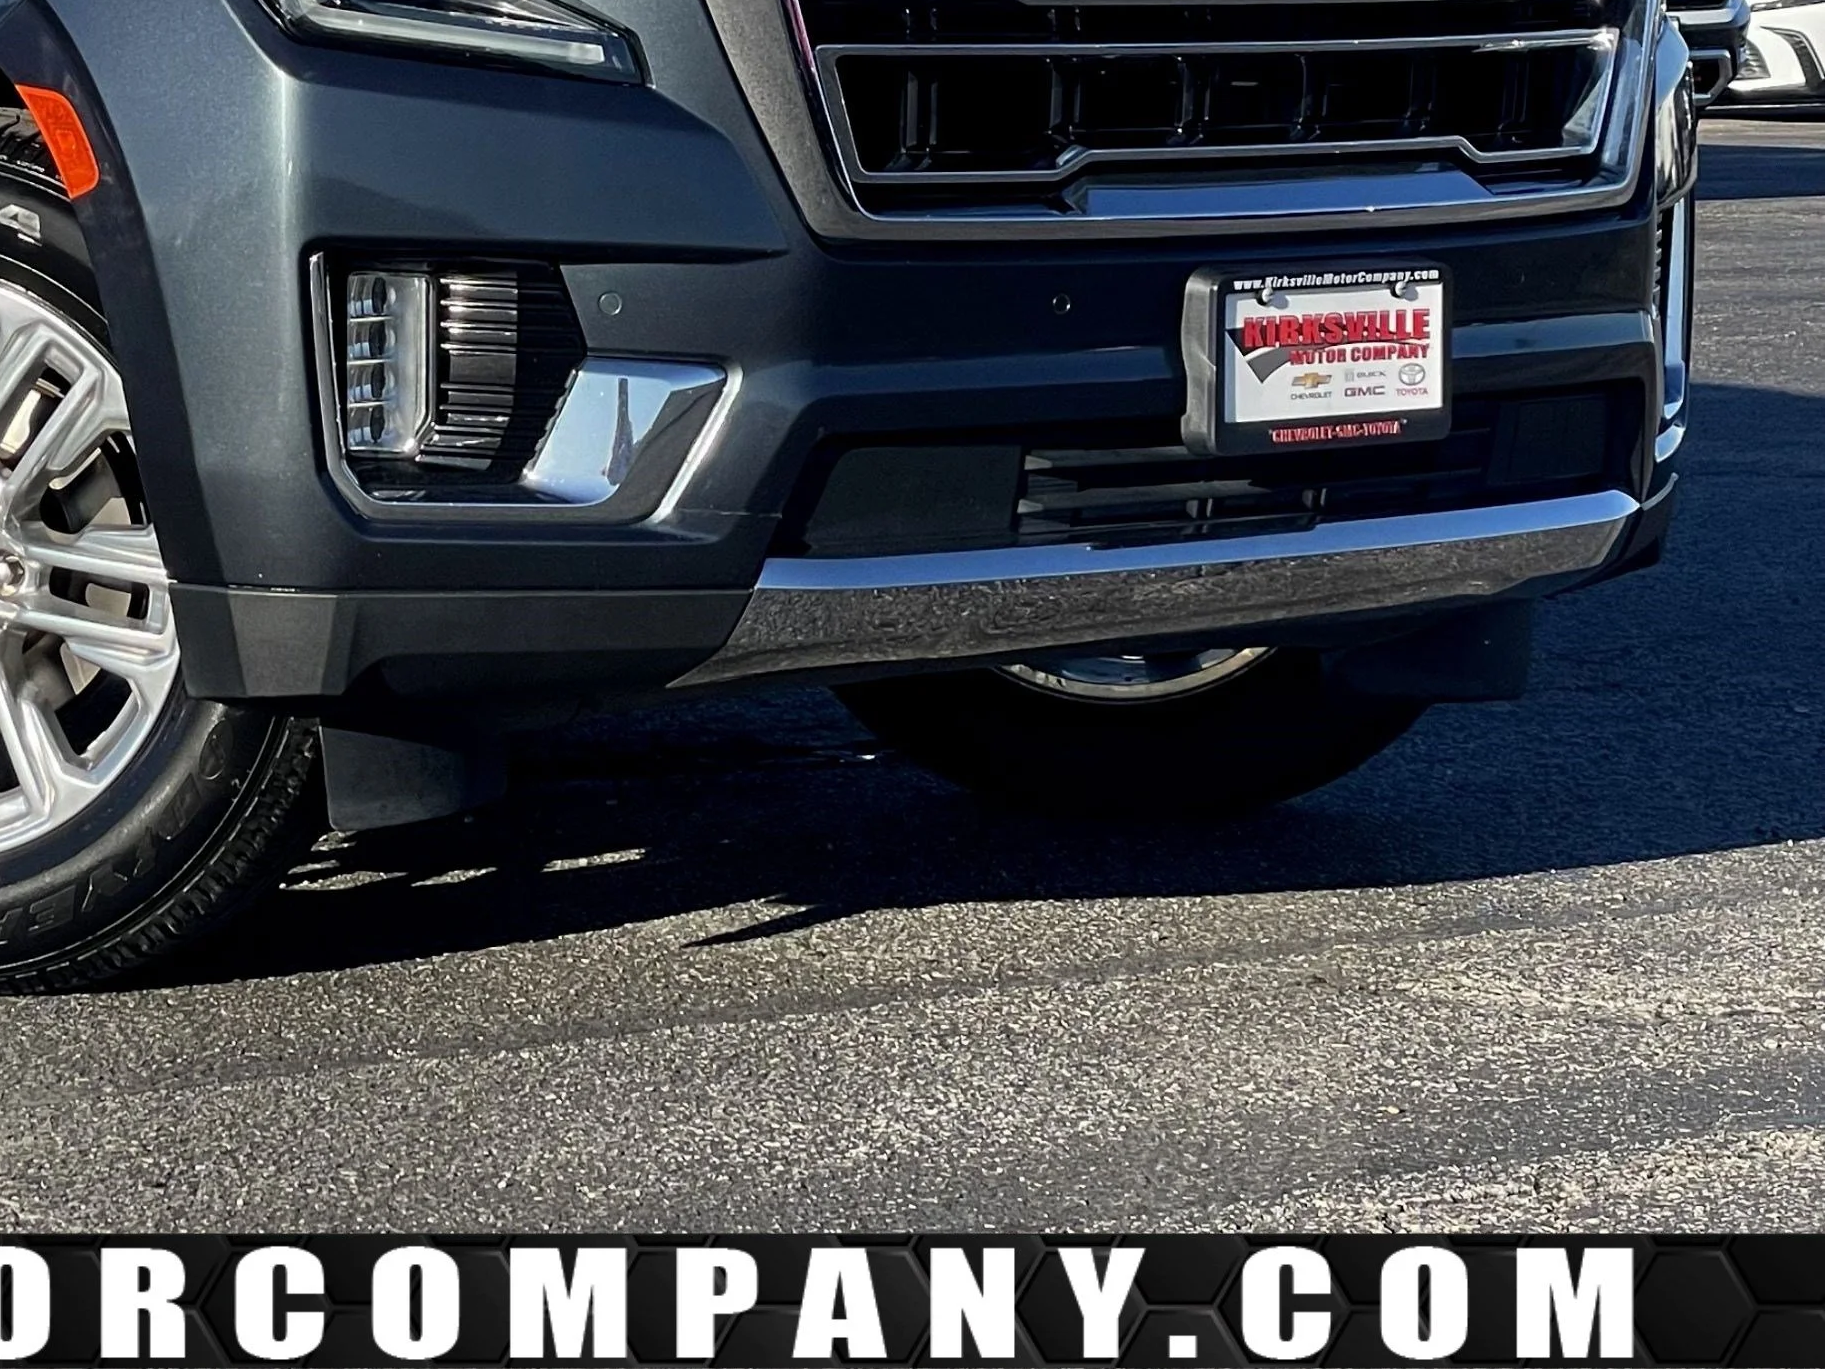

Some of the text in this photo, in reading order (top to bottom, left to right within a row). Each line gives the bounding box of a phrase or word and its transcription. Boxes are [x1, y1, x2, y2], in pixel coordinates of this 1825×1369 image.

[1233, 269, 1440, 291] www.KirksvilleMotorCompany.com
[1241, 307, 1431, 348] KIRKSVILLE
[1289, 343, 1430, 366] MOTOR COMPANY
[1356, 370, 1386, 379] BUICK
[1290, 391, 1332, 400] CHEVROLET
[1344, 385, 1386, 398] GMC
[1396, 387, 1429, 397] TOYOTA
